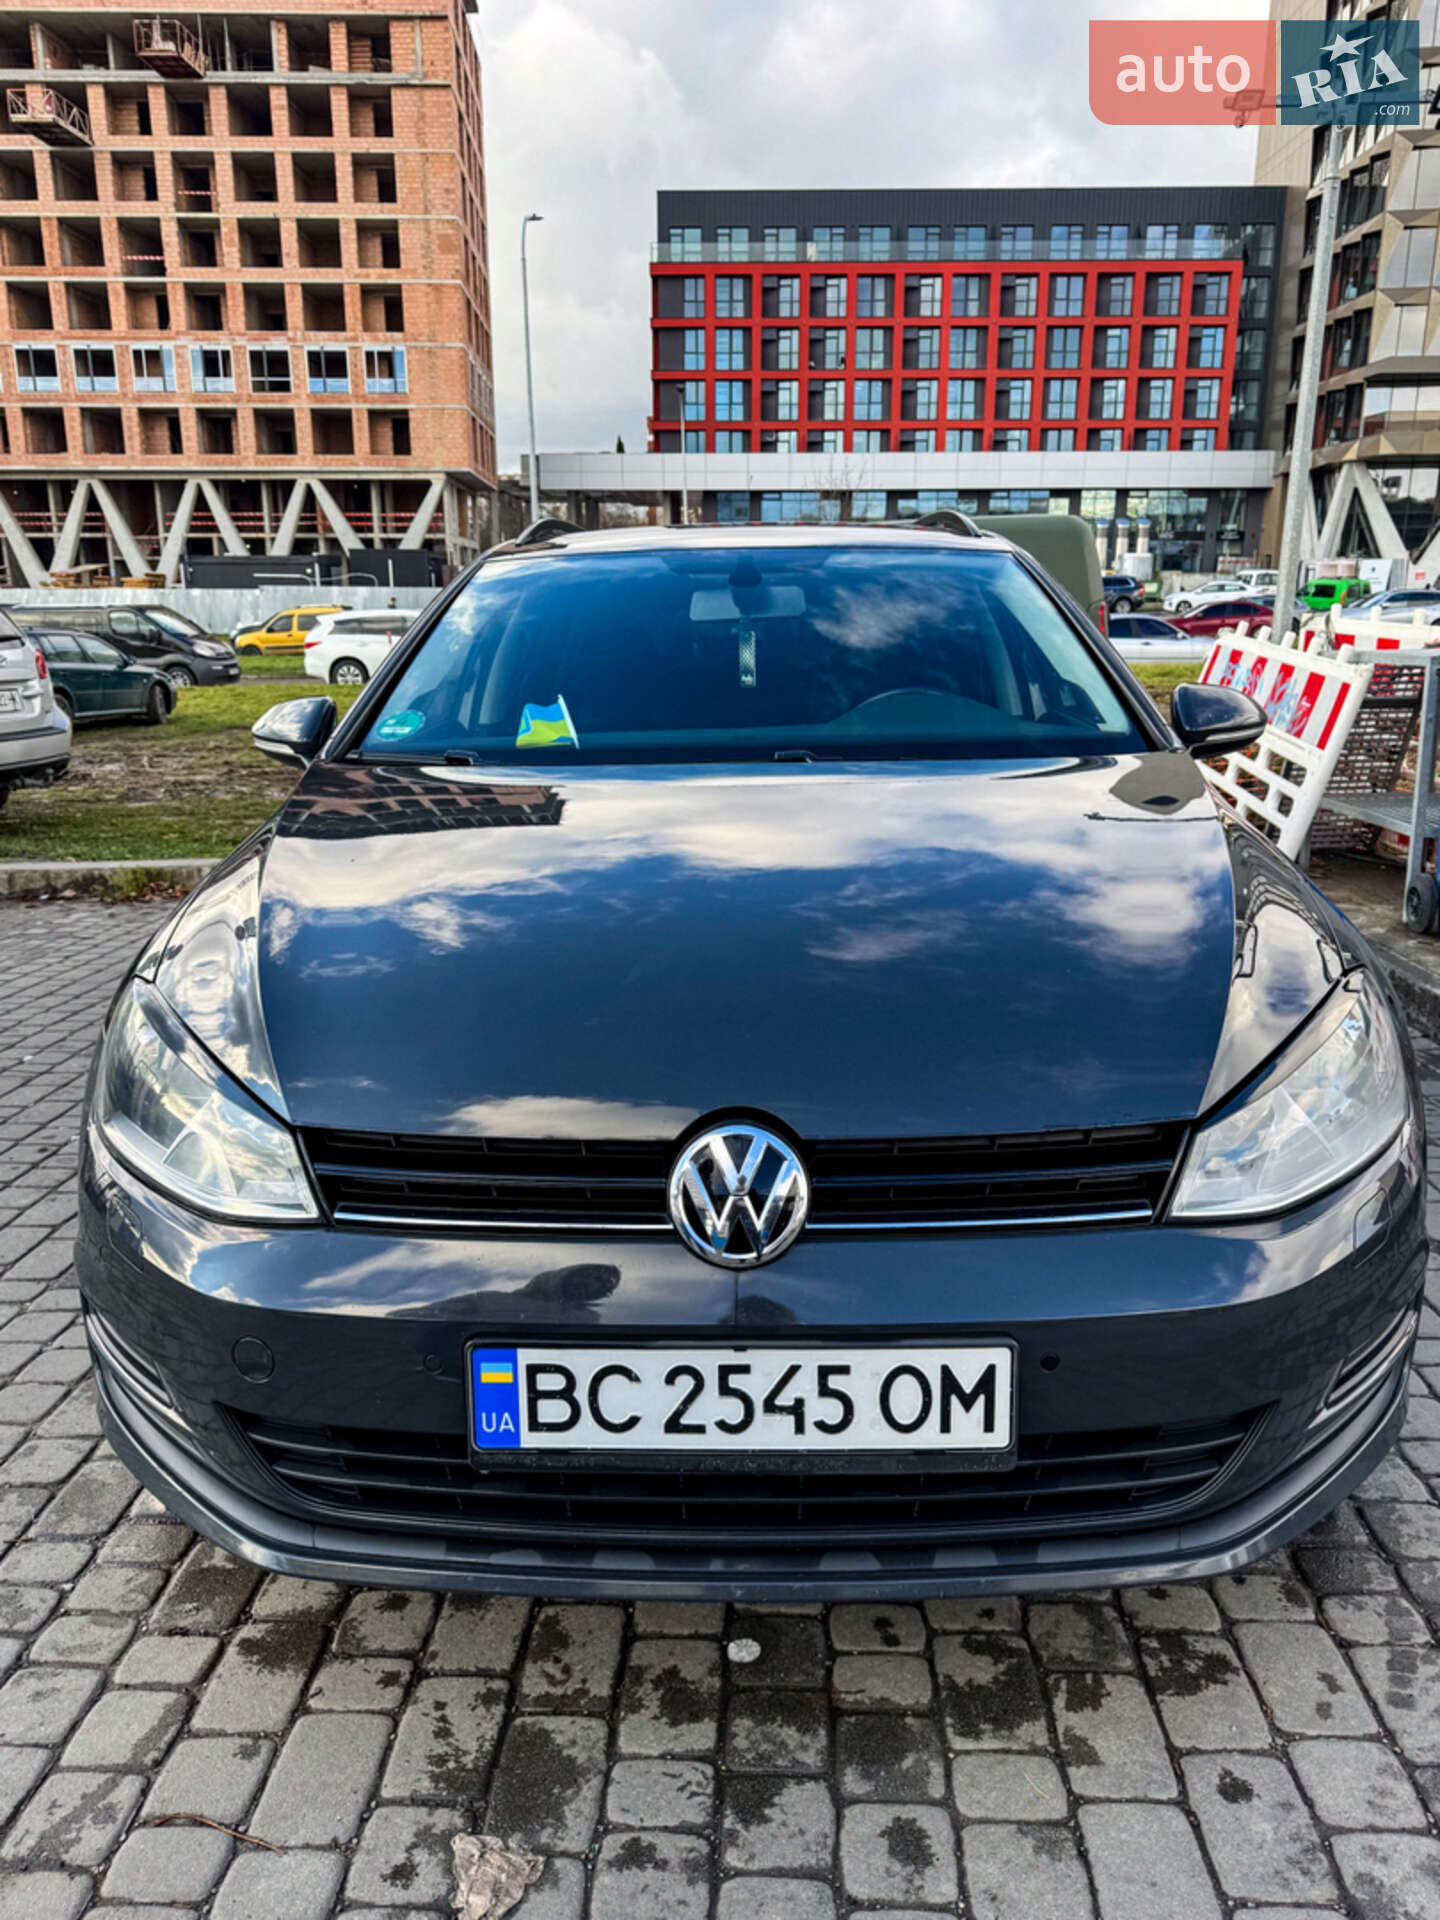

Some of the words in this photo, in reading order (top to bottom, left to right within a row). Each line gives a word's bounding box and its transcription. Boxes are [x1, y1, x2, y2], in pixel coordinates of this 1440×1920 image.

[525, 1363, 642, 1434] BC
[663, 1364, 855, 1435] 2545
[879, 1363, 997, 1434] OM
[482, 1412, 515, 1433] UA
